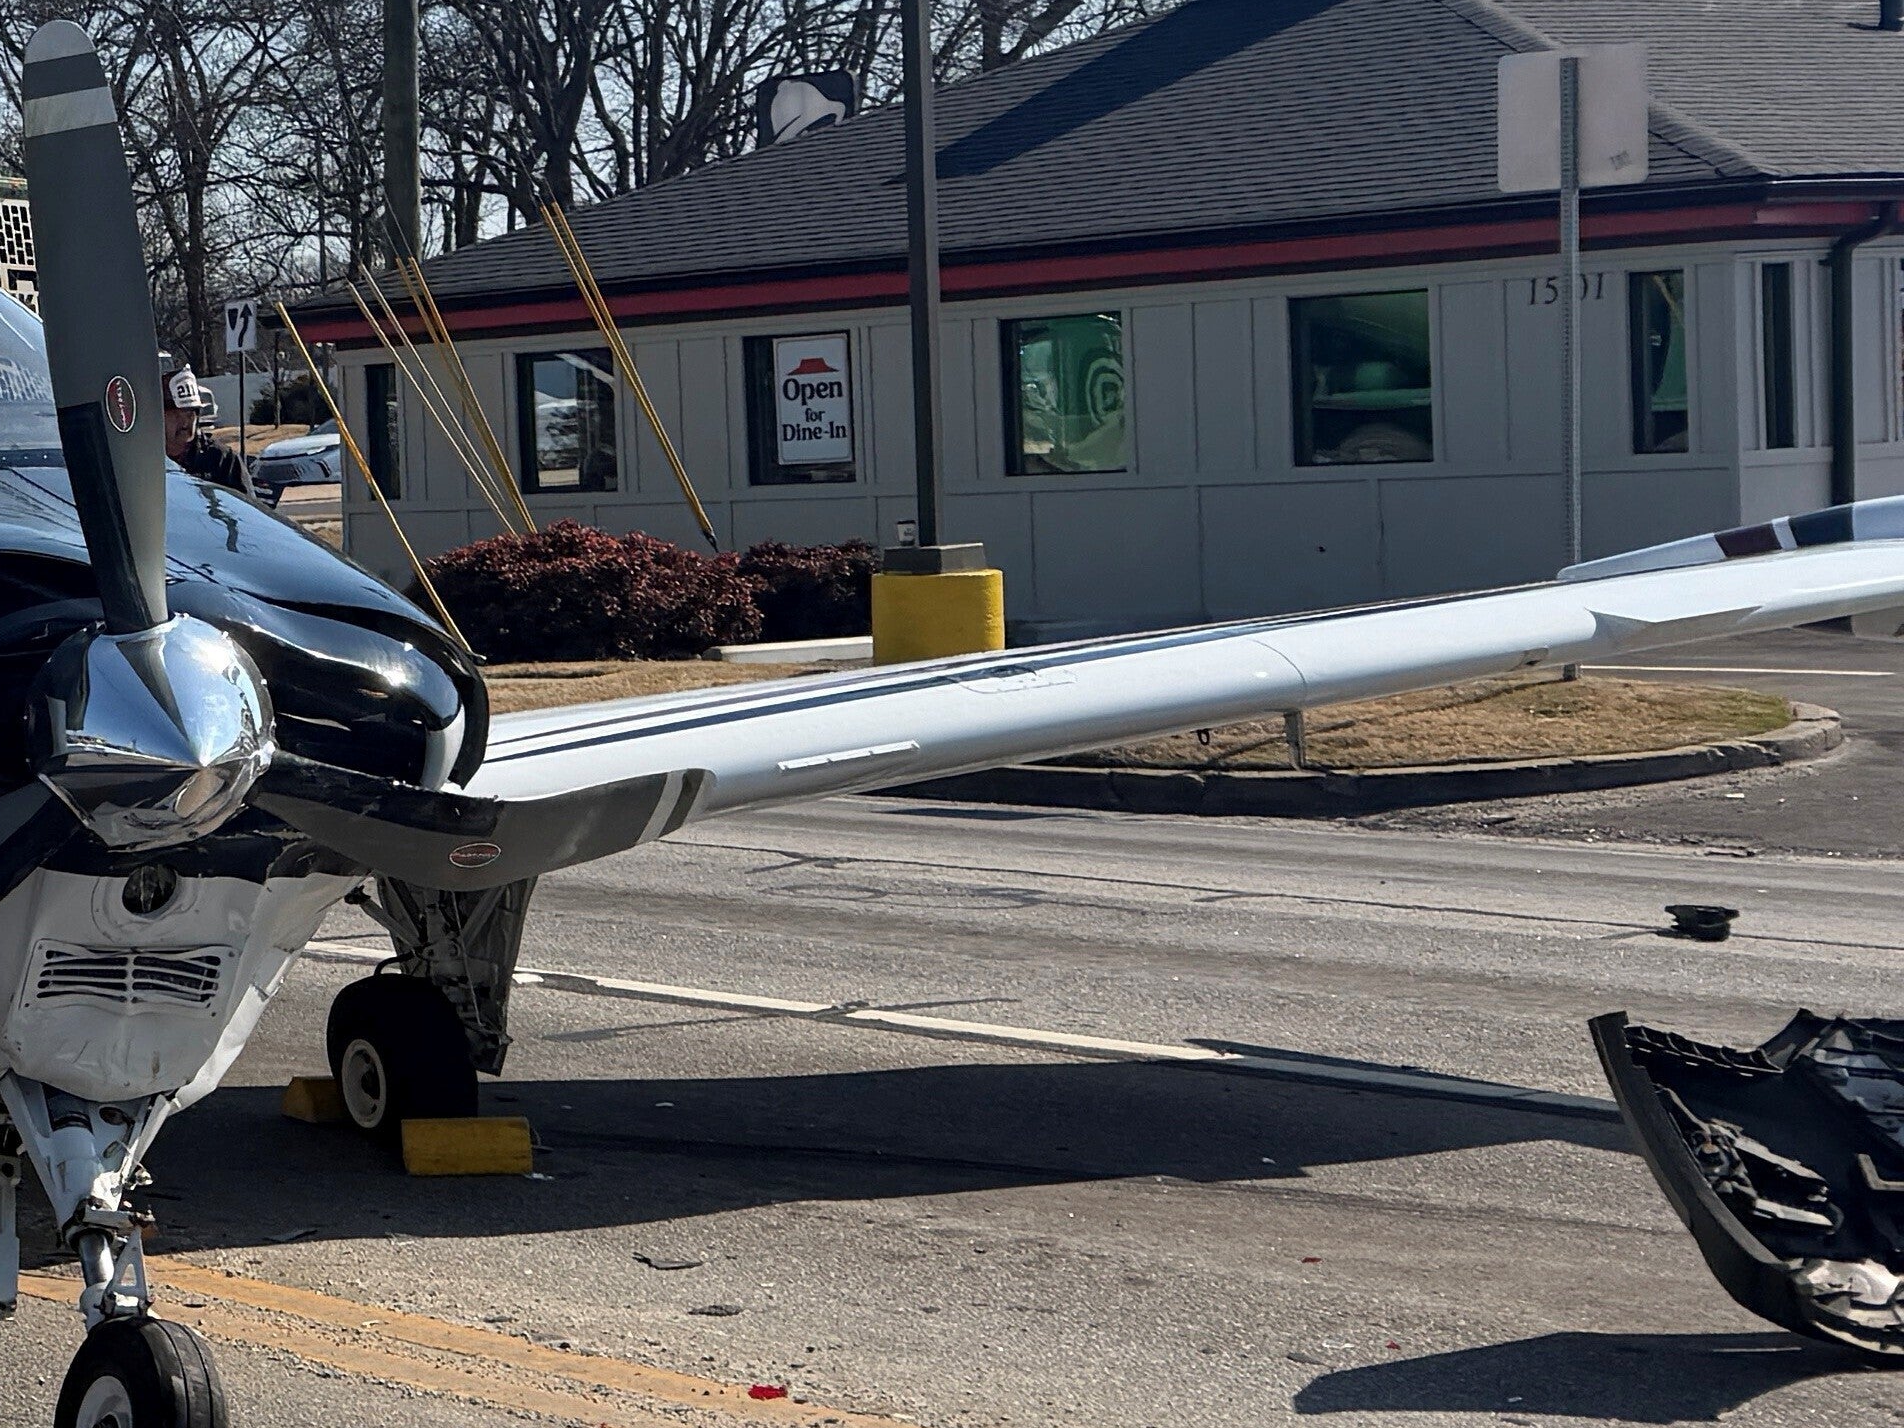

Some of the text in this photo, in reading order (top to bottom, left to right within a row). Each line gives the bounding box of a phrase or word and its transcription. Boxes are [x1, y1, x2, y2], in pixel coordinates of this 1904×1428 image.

[782, 378, 844, 406] Open
[804, 408, 826, 422] for
[782, 421, 847, 442] Dine-In
